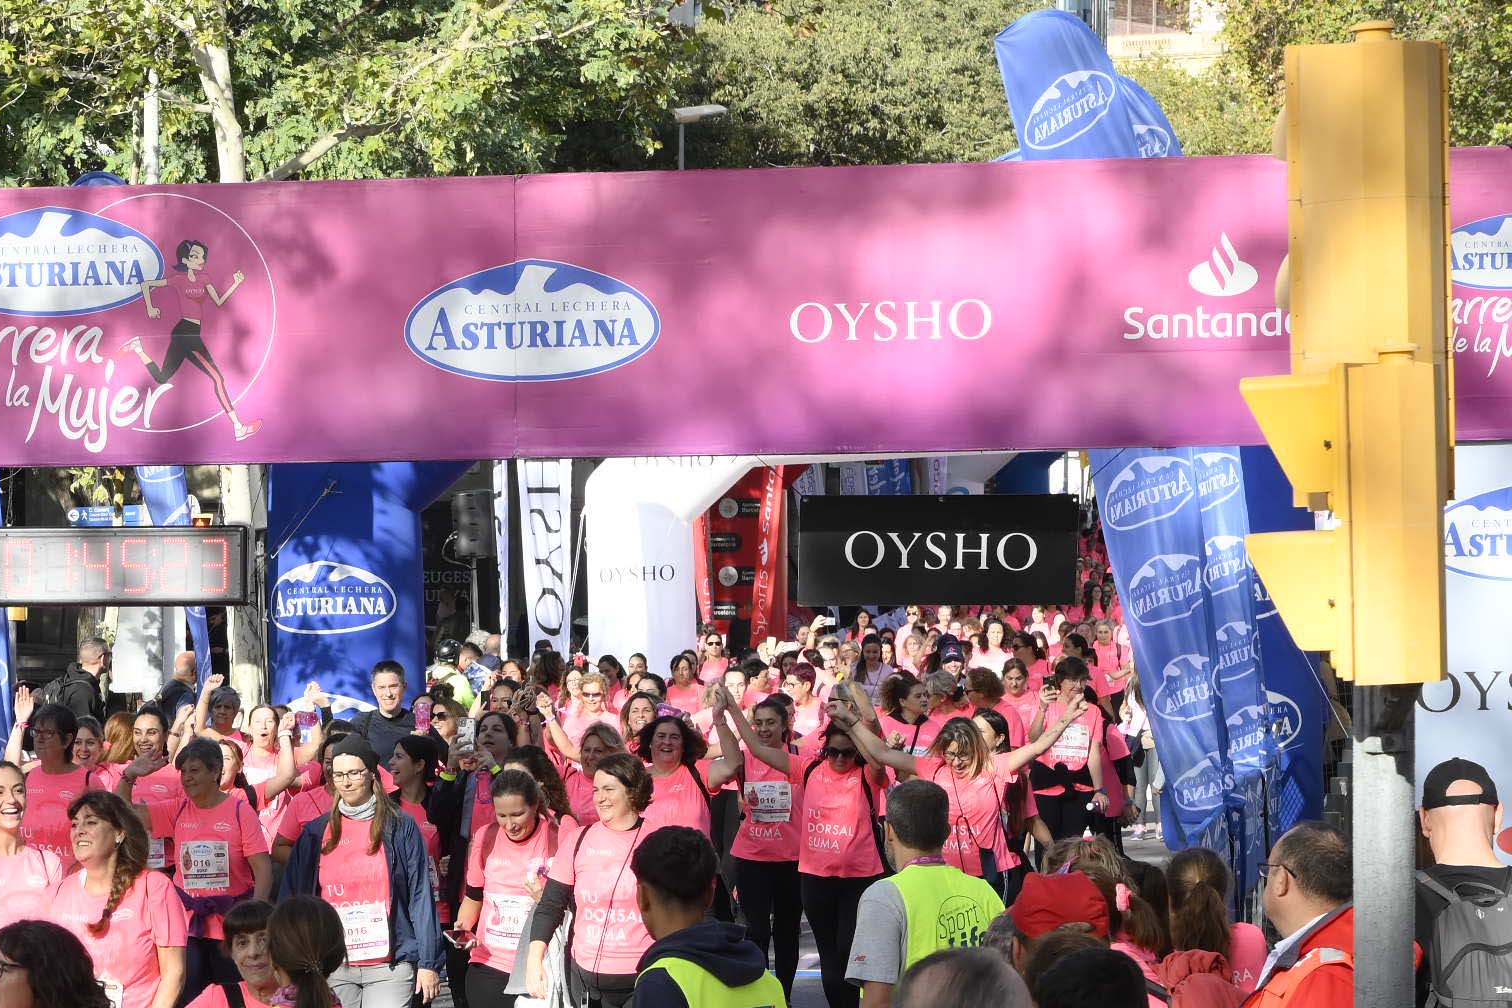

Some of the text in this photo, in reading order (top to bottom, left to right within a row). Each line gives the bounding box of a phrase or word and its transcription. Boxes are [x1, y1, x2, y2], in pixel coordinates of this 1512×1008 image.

[66, 243, 139, 255] LECHERA
[464, 300, 632, 315] CENTRAL LECHERA
[789, 299, 993, 343] OYSHO
[424, 307, 641, 352] ASTURIANA
[6, 367, 30, 407] la
[25, 359, 174, 454] Mujer
[844, 530, 1038, 572] OYSHO
[599, 564, 675, 585] OYSHO
[288, 585, 383, 596] CENTRAL LECHERA
[276, 590, 387, 618] ASTURIANA
[808, 807, 822, 818] TU
[750, 825, 782, 838] SUMA
[808, 822, 854, 837] DORSAL
[808, 837, 840, 850] SUMA
[326, 883, 345, 897] TU
[938, 903, 980, 940] Sport
